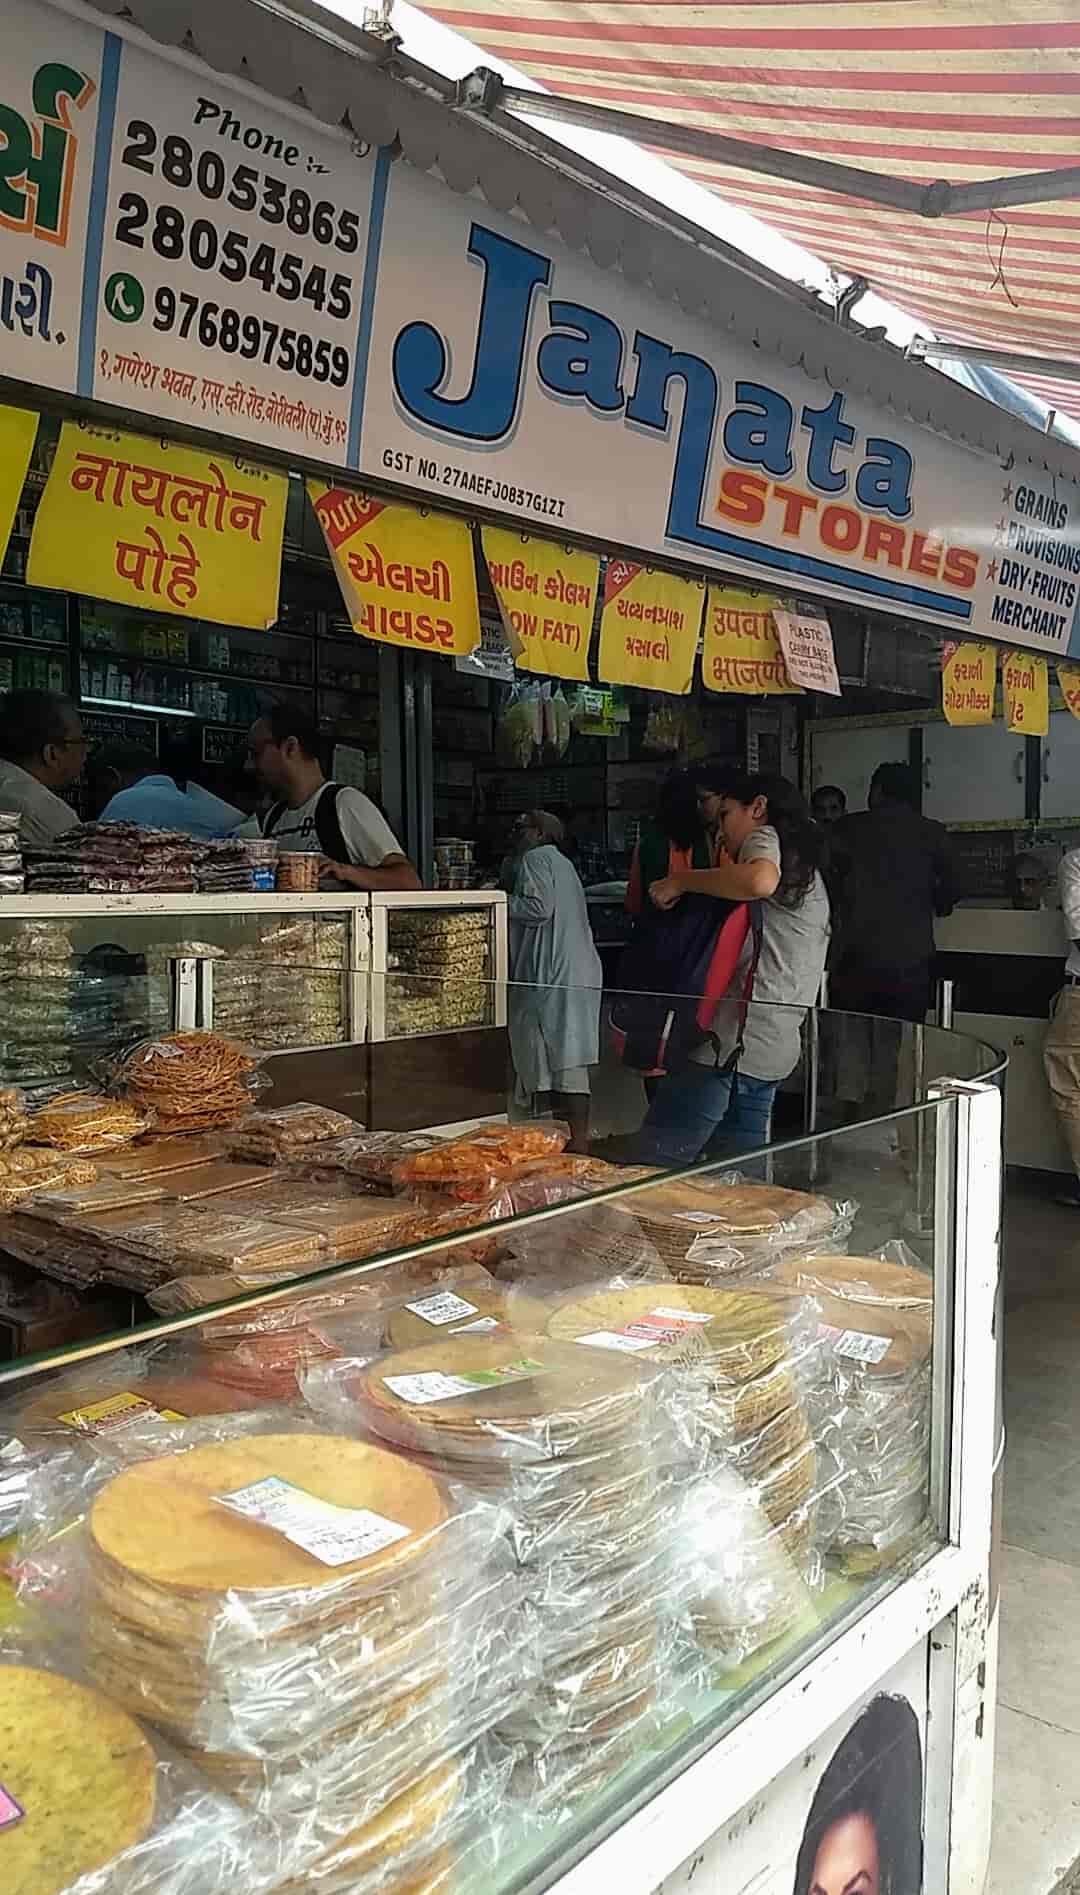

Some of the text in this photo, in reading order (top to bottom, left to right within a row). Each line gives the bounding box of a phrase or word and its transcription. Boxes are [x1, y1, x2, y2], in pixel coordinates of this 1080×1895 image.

[194, 97, 299, 166] Phone
[121, 119, 360, 254] 28053865
[115, 192, 353, 320] 28054545
[153, 286, 350, 388] 9768975859
[392, 222, 916, 541] Janata
[71, 452, 267, 542] नायलोन
[382, 449, 414, 473] GST
[418, 458, 440, 482] NO.
[715, 469, 980, 591] STORES
[1014, 485, 1068, 529] GRAINS
[116, 526, 201, 608] पोहे
[348, 542, 452, 603] એલચી
[1008, 520, 1080, 575] PROVISIONS
[509, 611, 580, 653] OW FAT)
[991, 595, 1067, 640] MERCHANT
